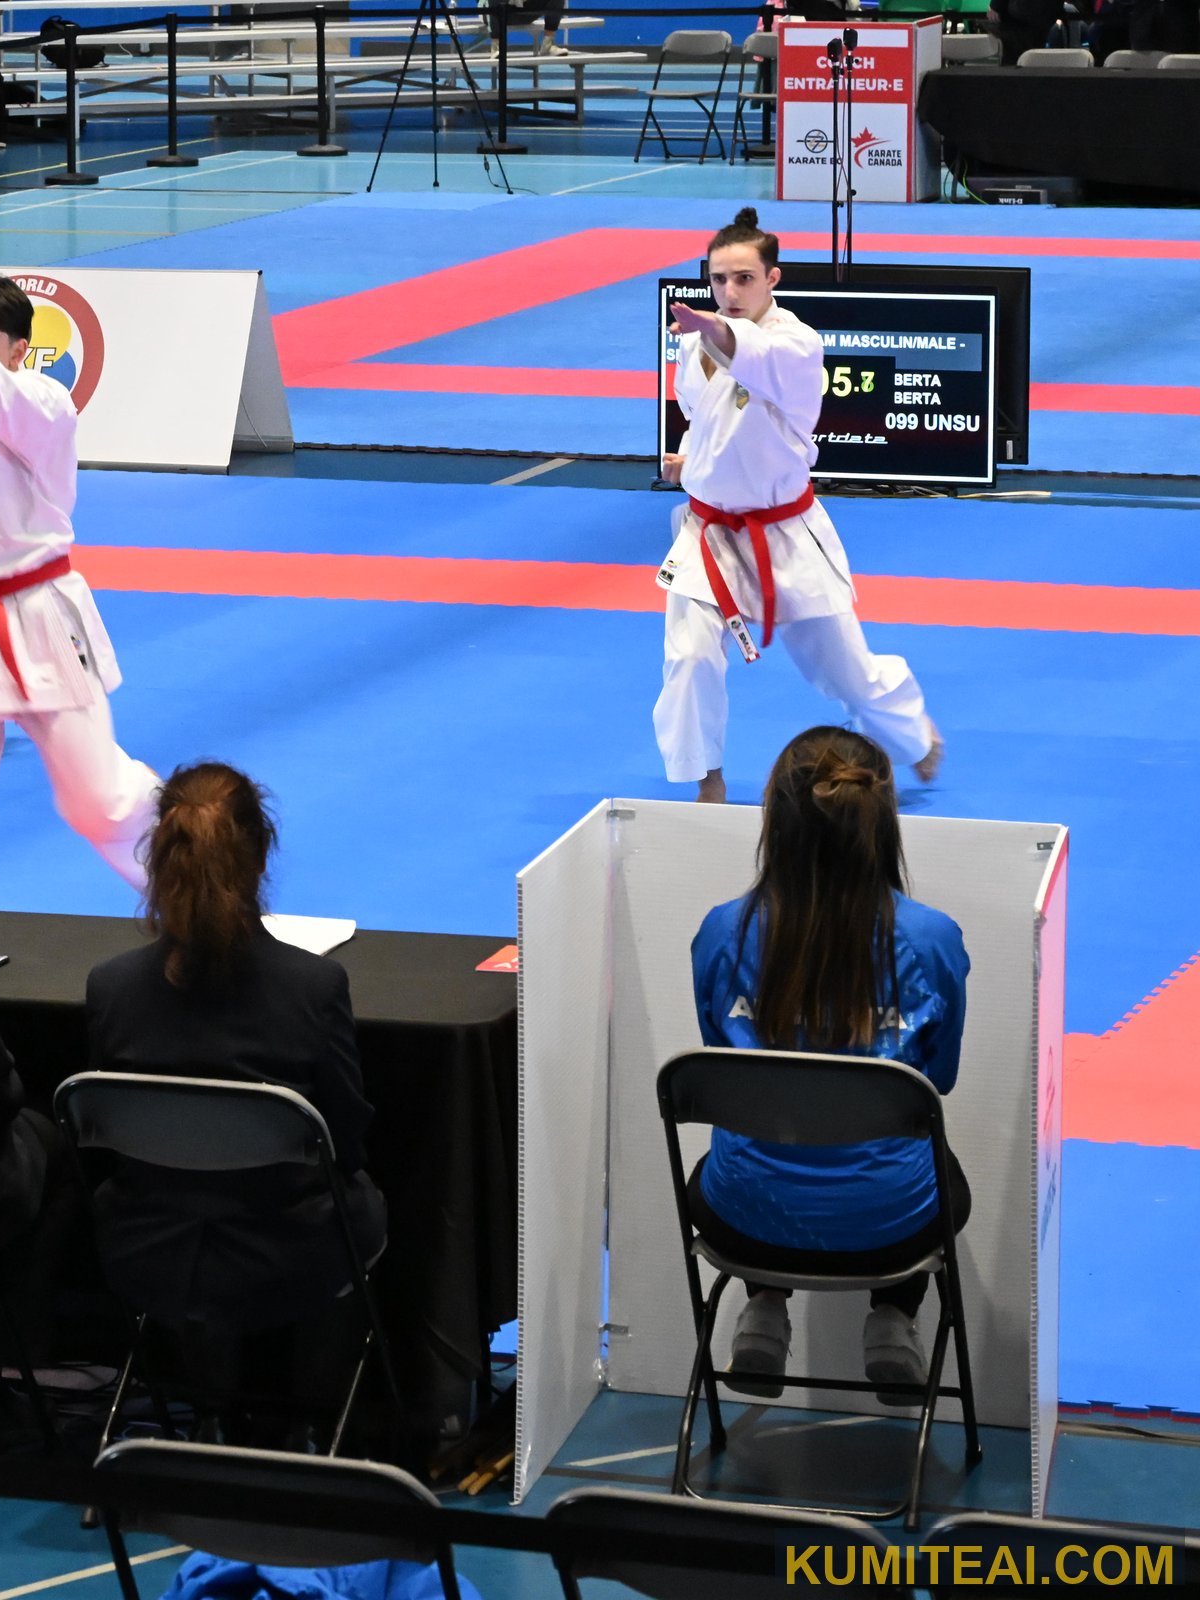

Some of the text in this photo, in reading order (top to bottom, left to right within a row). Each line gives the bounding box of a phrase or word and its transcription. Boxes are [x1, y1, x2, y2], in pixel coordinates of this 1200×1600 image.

[788, 156, 827, 165] KARATE
[868, 149, 902, 158] KARATE
[868, 158, 902, 167] CANADA
[12, 278, 58, 297] ORLD
[840, 334, 956, 350] MASCULIN/MALE
[894, 373, 942, 387] BERTA
[894, 391, 942, 405] BERTA
[885, 412, 981, 432] 099 UNSU
